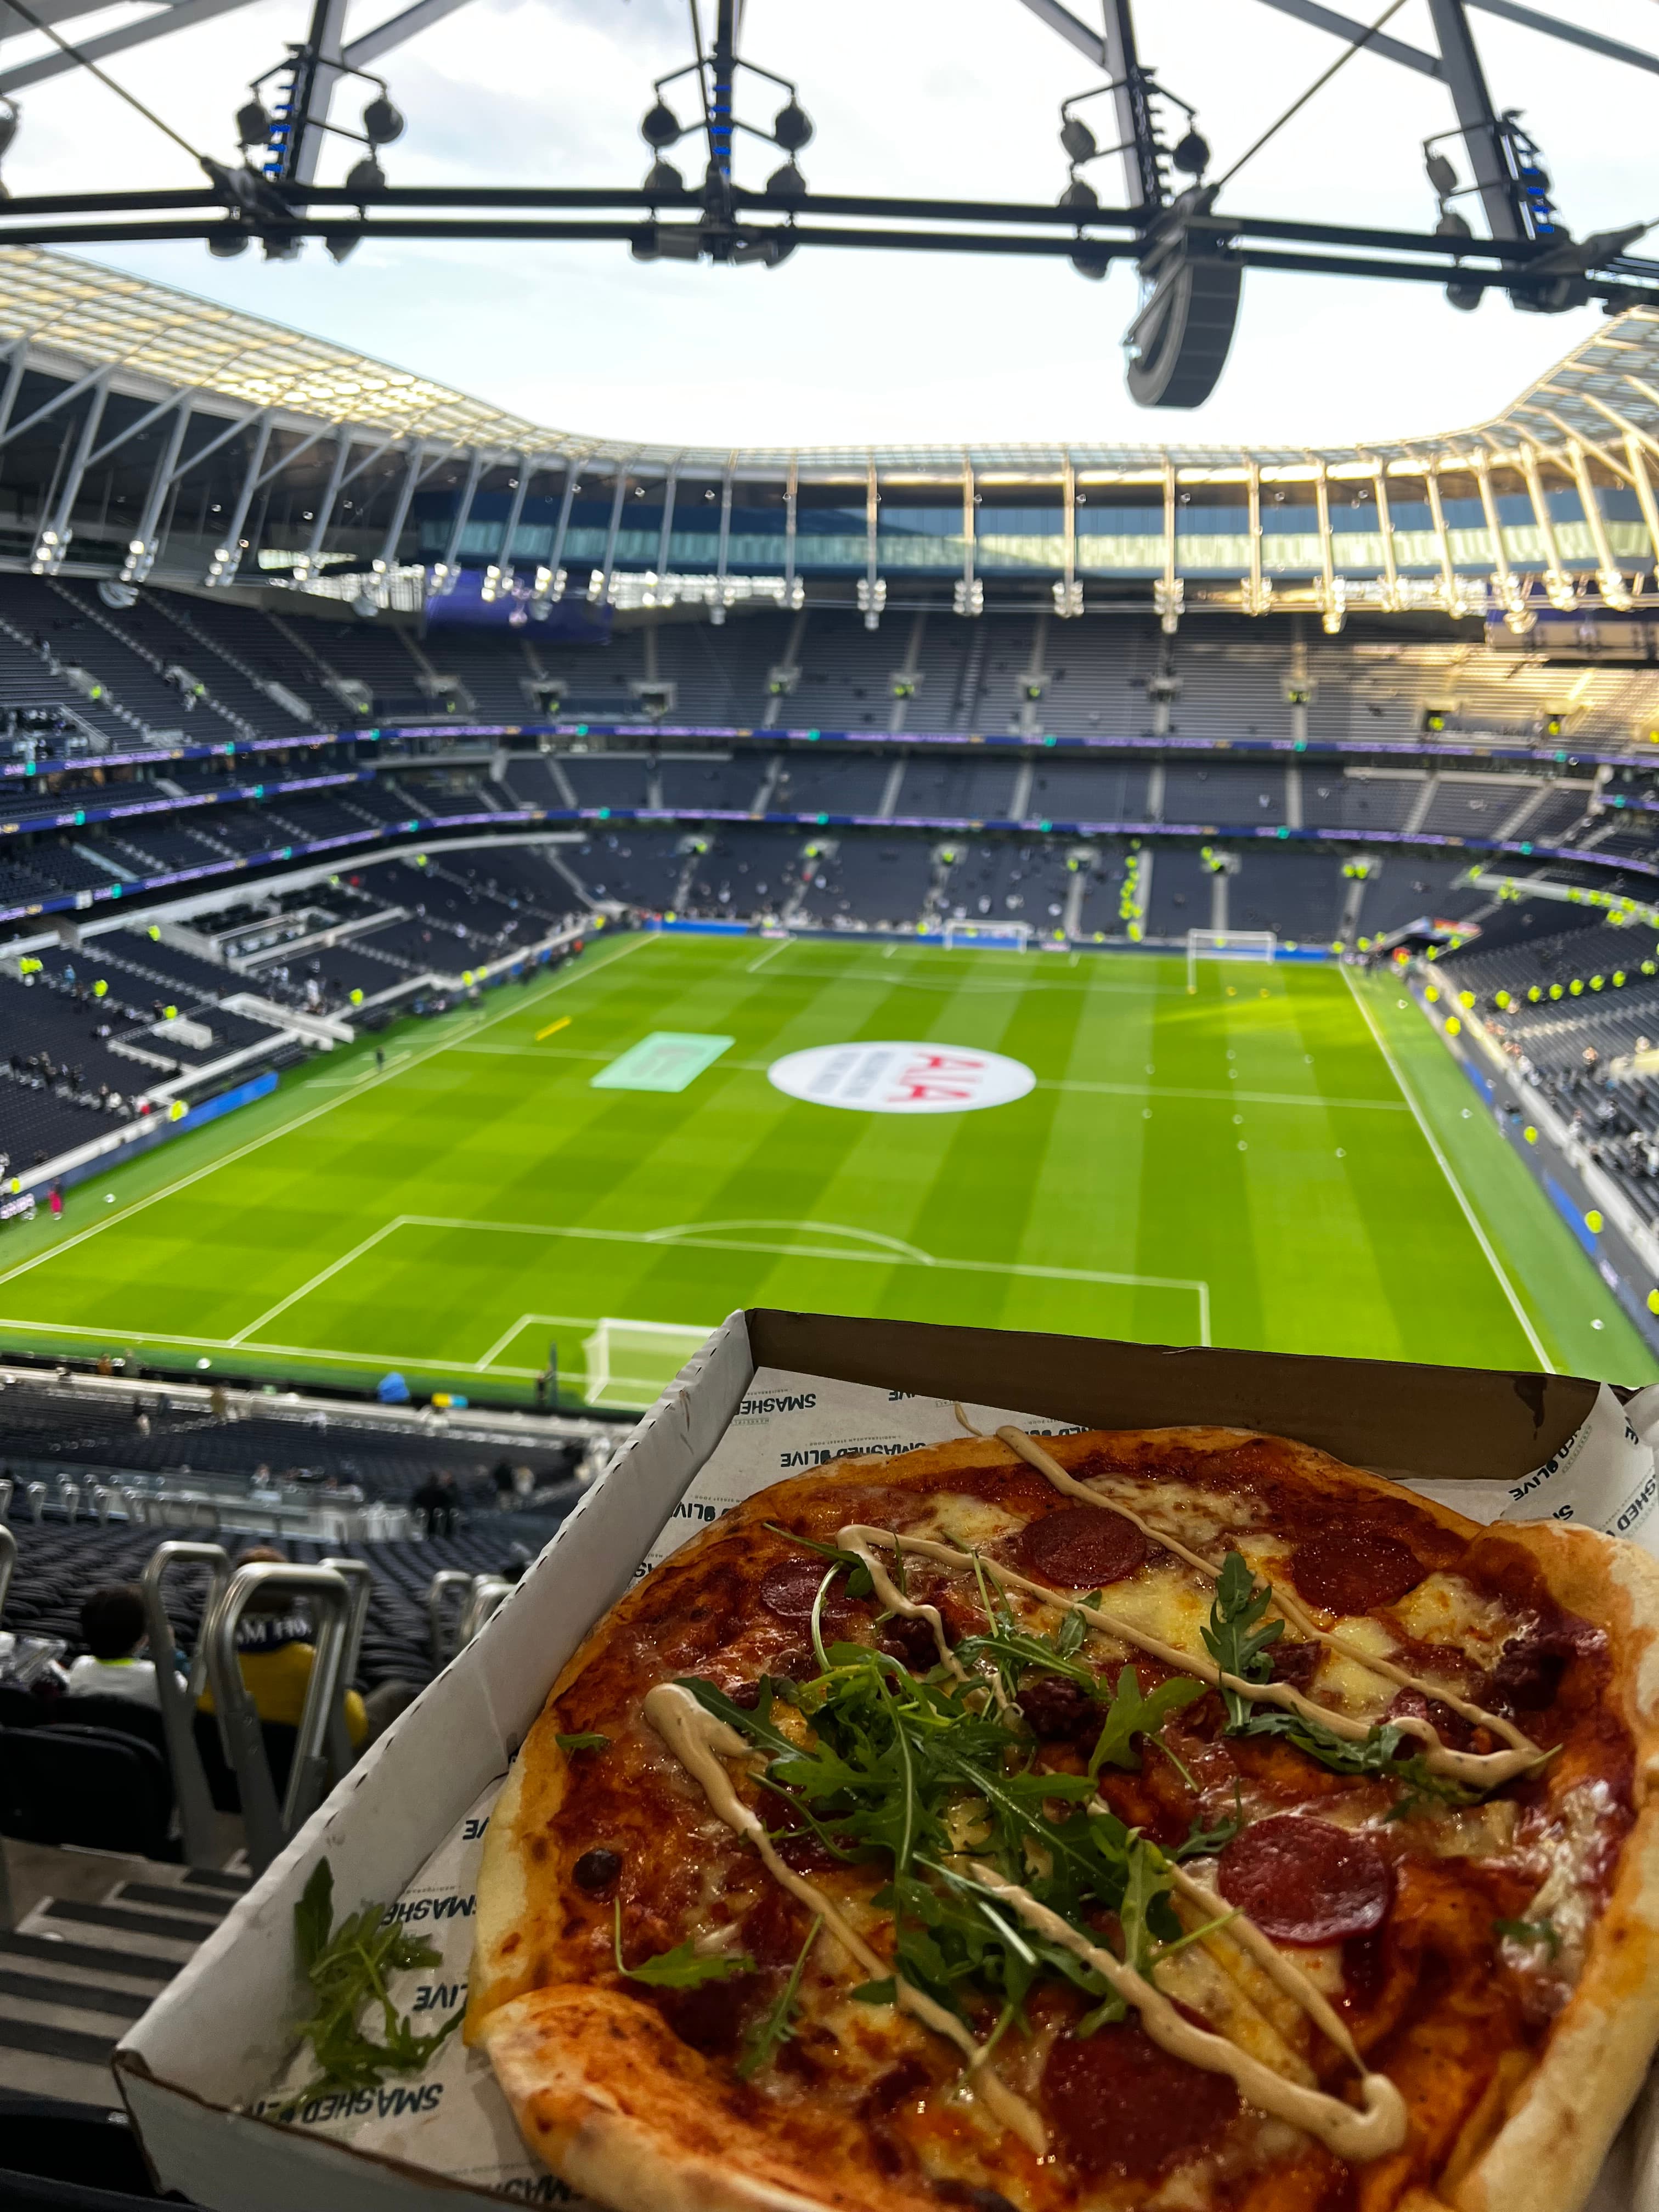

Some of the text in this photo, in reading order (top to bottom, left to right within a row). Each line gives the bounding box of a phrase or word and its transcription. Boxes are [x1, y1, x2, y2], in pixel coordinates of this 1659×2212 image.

[740, 1393, 816, 1415] SMASHE
[672, 1502, 715, 1522] OLIV
[303, 2083, 443, 2124] SMASHED
